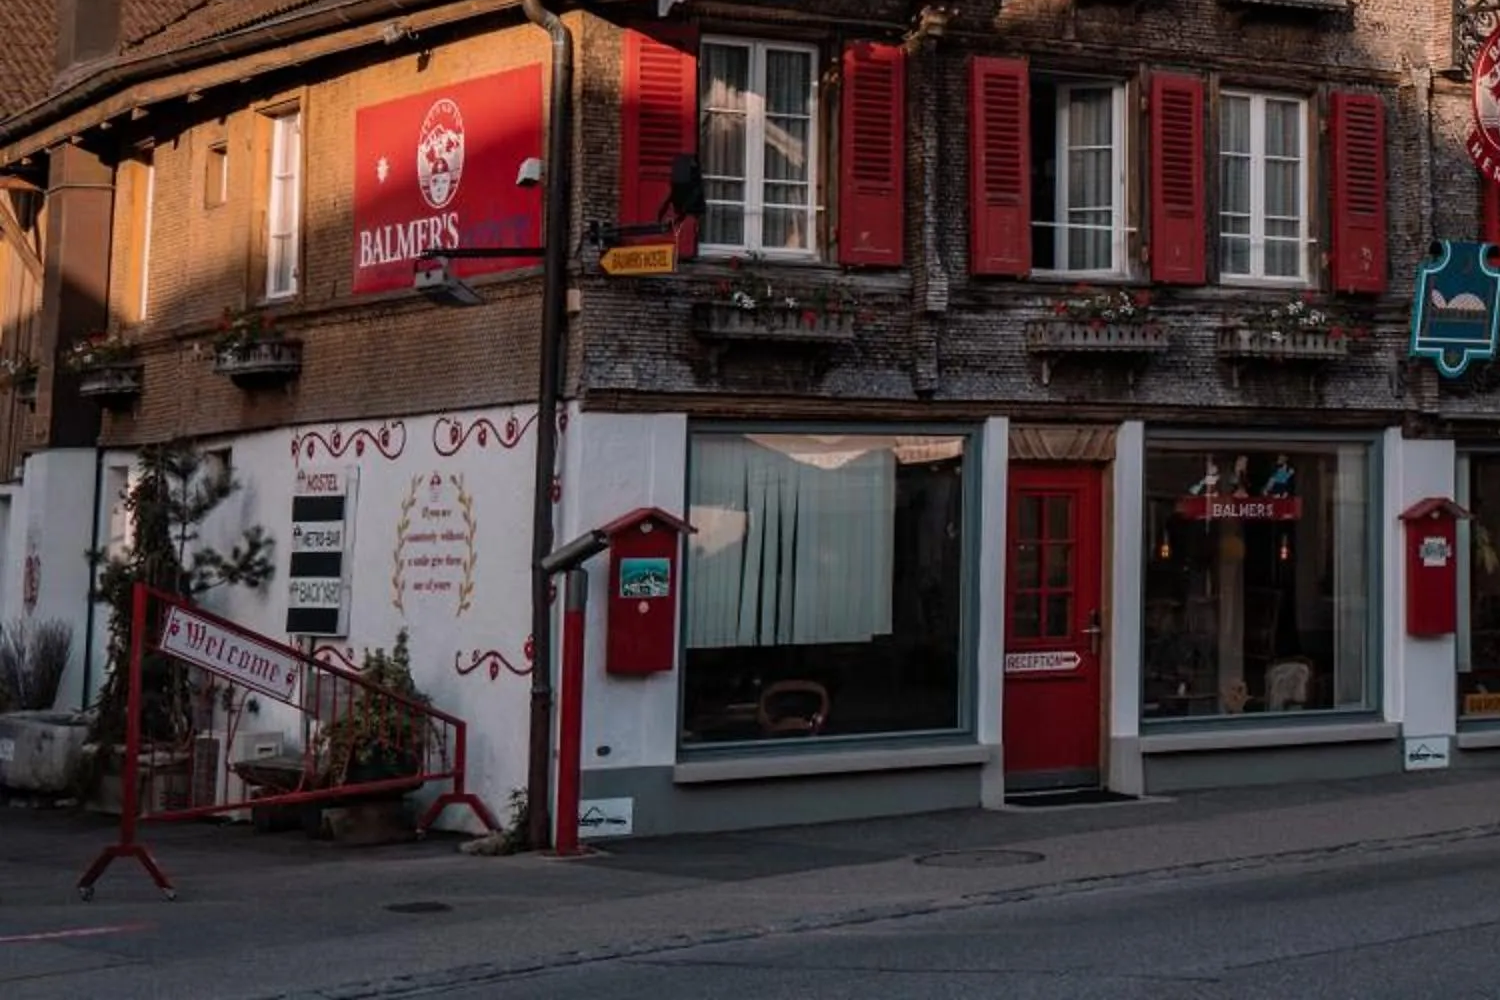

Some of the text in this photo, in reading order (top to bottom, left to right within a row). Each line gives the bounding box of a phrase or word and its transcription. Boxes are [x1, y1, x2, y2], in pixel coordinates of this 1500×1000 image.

[358, 211, 460, 268] BALMER'S
[186, 620, 281, 683] Welcome
[1007, 653, 1063, 669] RECEPTION
